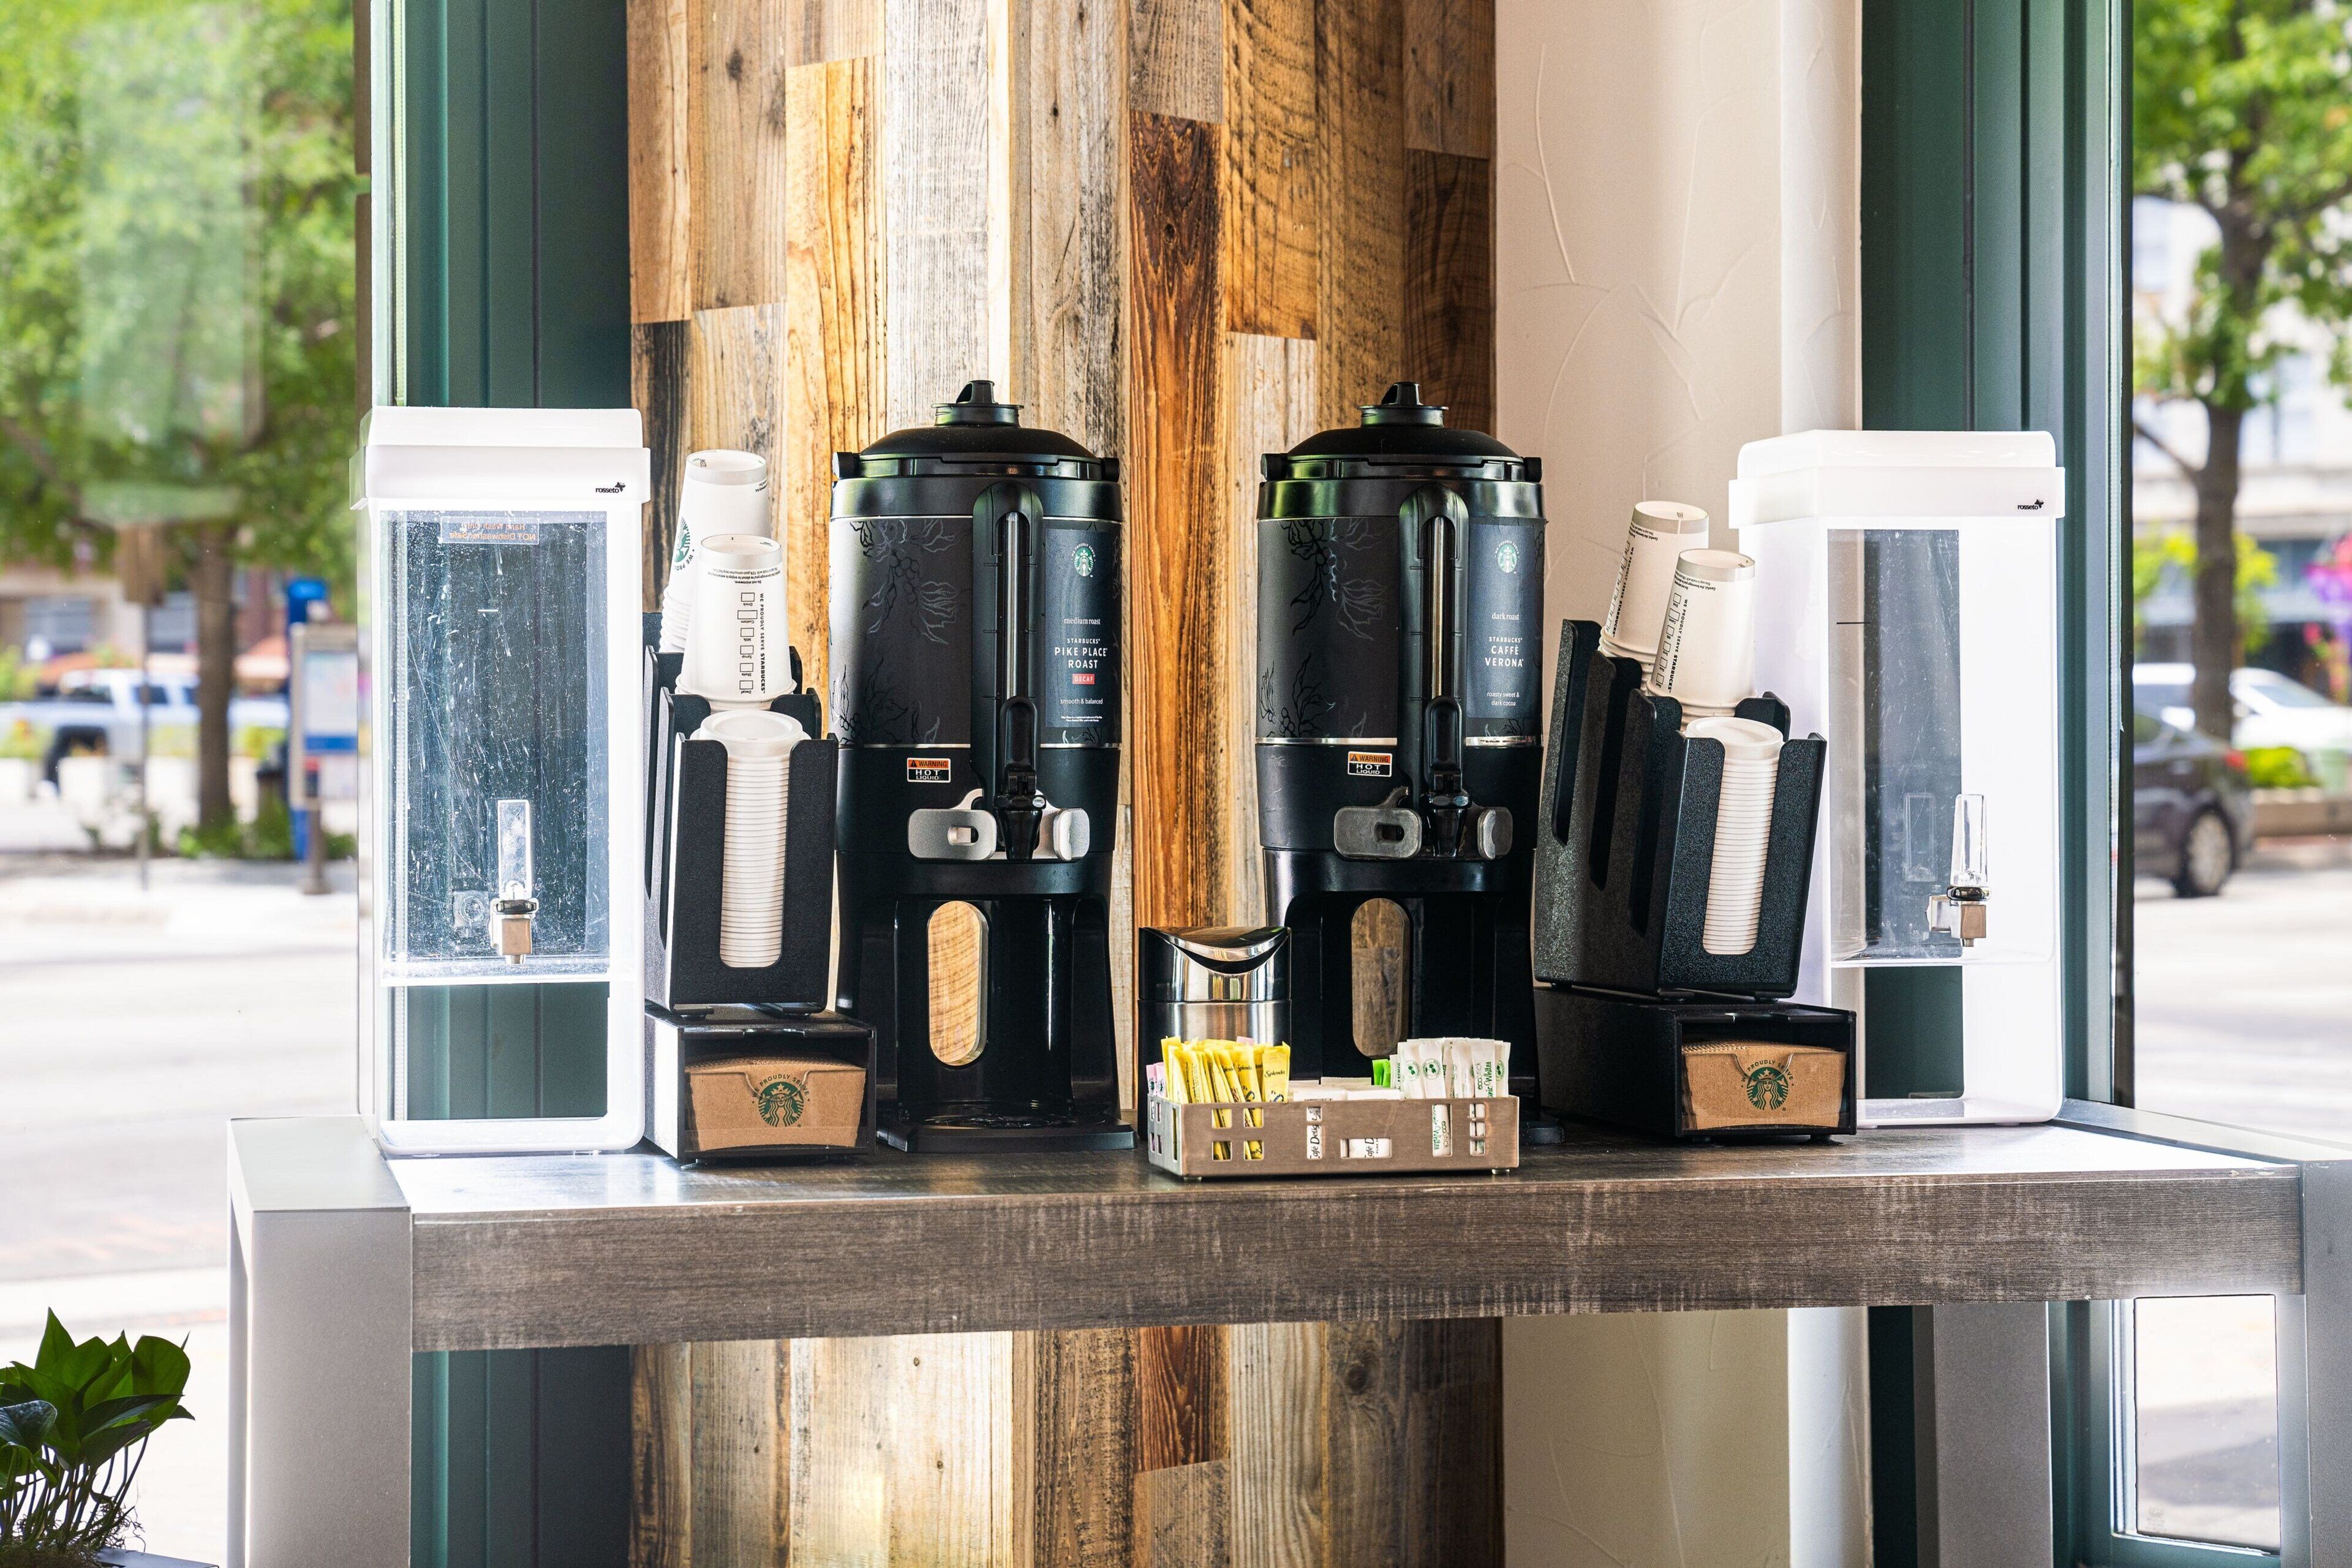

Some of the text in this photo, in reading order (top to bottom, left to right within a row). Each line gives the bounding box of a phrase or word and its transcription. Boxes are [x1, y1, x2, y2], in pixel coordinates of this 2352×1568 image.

[685, 554, 693, 564] WE
[760, 593, 764, 601] WE
[1054, 647, 1107, 657] PIKE PLACE
[1491, 644, 1519, 655] CAFFÈ
[1068, 660, 1098, 669] ROAST
[1485, 657, 1523, 668] VERONA
[1747, 1060, 1776, 1072] PROUDLY
[1264, 1069, 1286, 1078] Splenda
[1483, 1061, 1493, 1085] Whites
[760, 1074, 791, 1087] PROUDLY
[1310, 1146, 1320, 1159] afé
